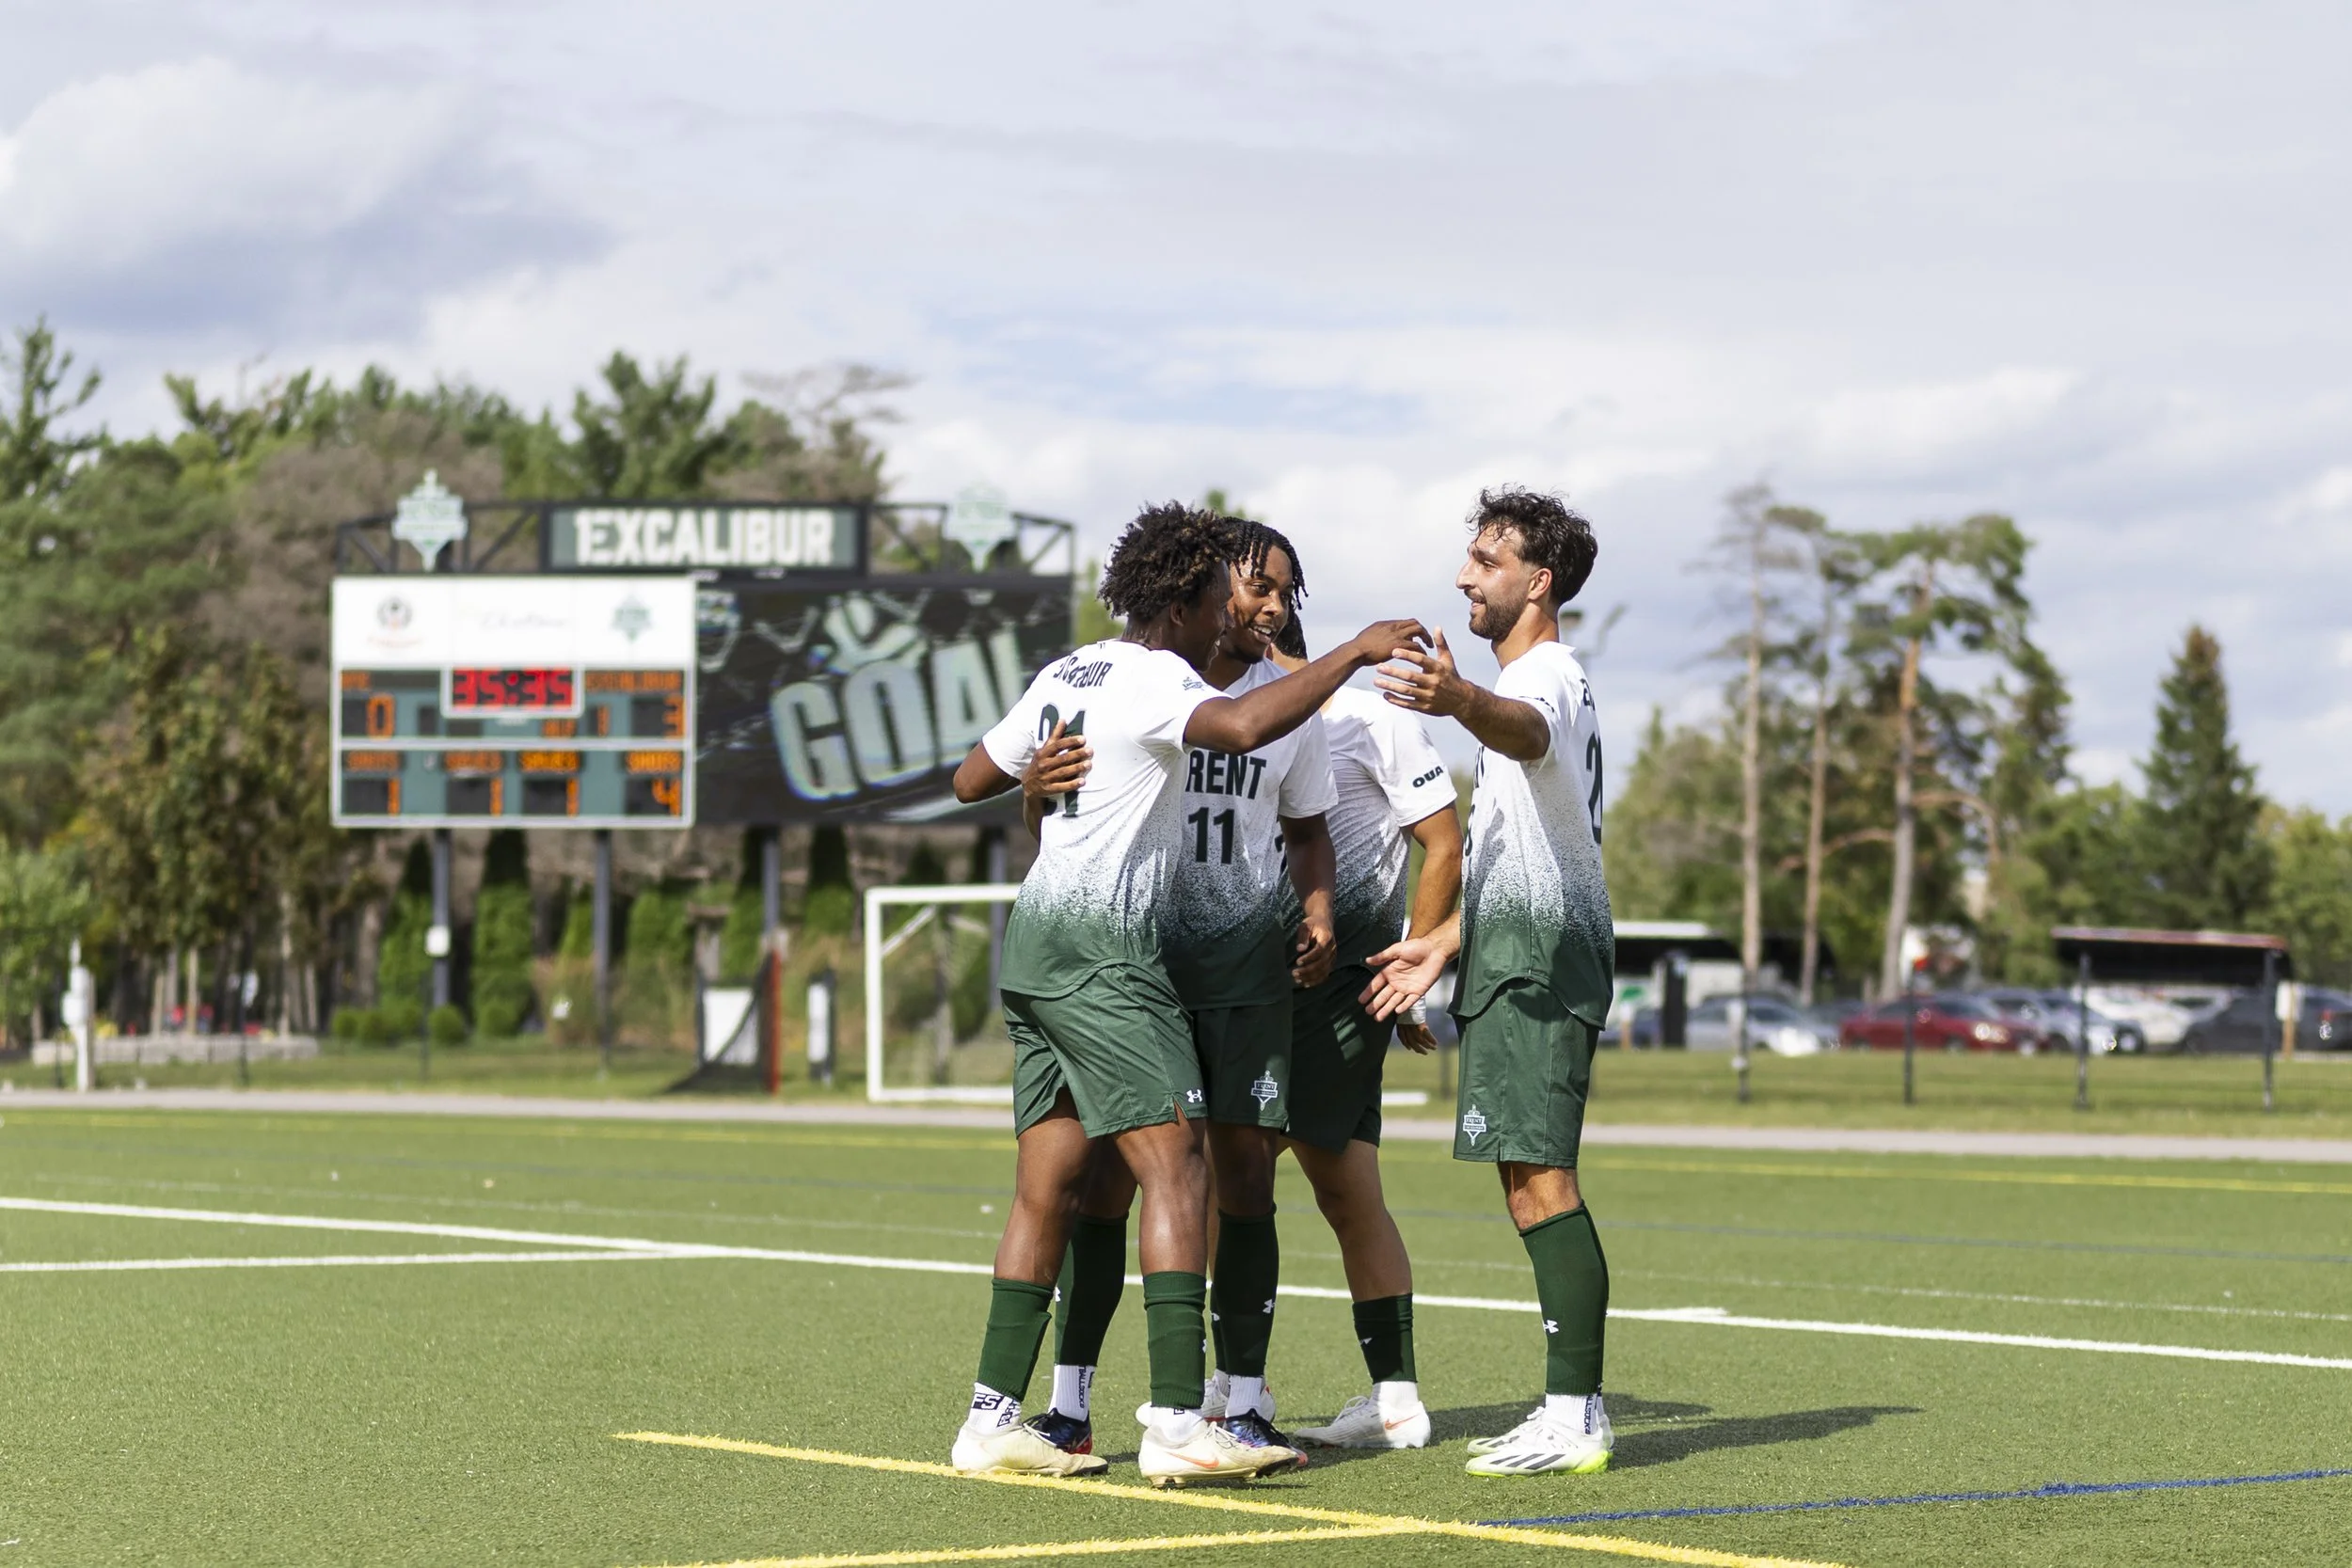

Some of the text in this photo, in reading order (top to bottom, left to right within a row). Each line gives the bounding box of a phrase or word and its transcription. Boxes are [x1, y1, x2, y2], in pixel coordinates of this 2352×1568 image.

[574, 508, 834, 565] EXCALIBUR
[452, 668, 573, 710] 35:35
[366, 693, 395, 740] 0
[662, 694, 685, 740] 3
[651, 777, 681, 817] 4
[1184, 750, 1266, 800] RENT
[1412, 766, 1444, 788] OUA
[1586, 731, 1603, 844] 2
[1187, 807, 1234, 863] 11
[972, 1393, 1003, 1410] FS
